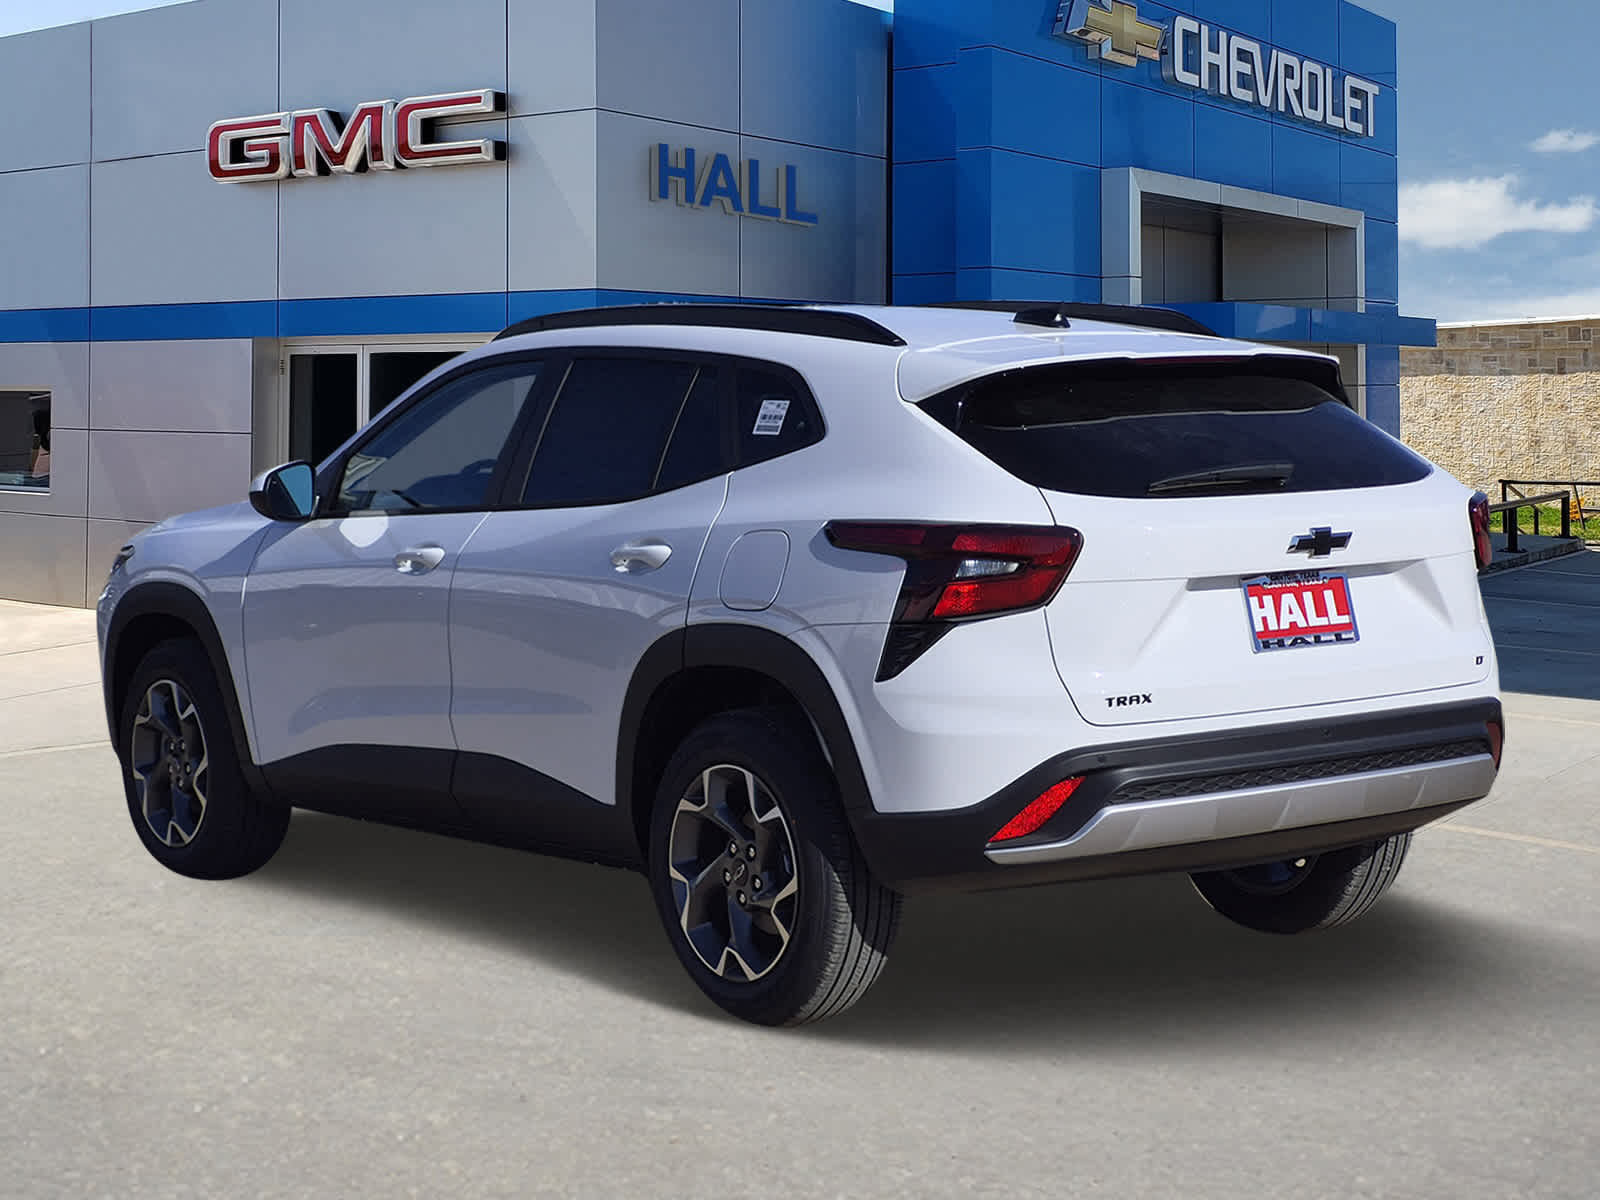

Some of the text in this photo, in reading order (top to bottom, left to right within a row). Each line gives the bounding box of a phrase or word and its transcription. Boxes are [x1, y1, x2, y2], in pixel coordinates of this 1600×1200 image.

[1172, 14, 1380, 137] CHEVROLET
[207, 88, 502, 184] GMC
[650, 142, 819, 226] HALL
[1248, 588, 1351, 632] HALL
[1261, 632, 1355, 650] HALL
[1105, 692, 1153, 708] TRAX
